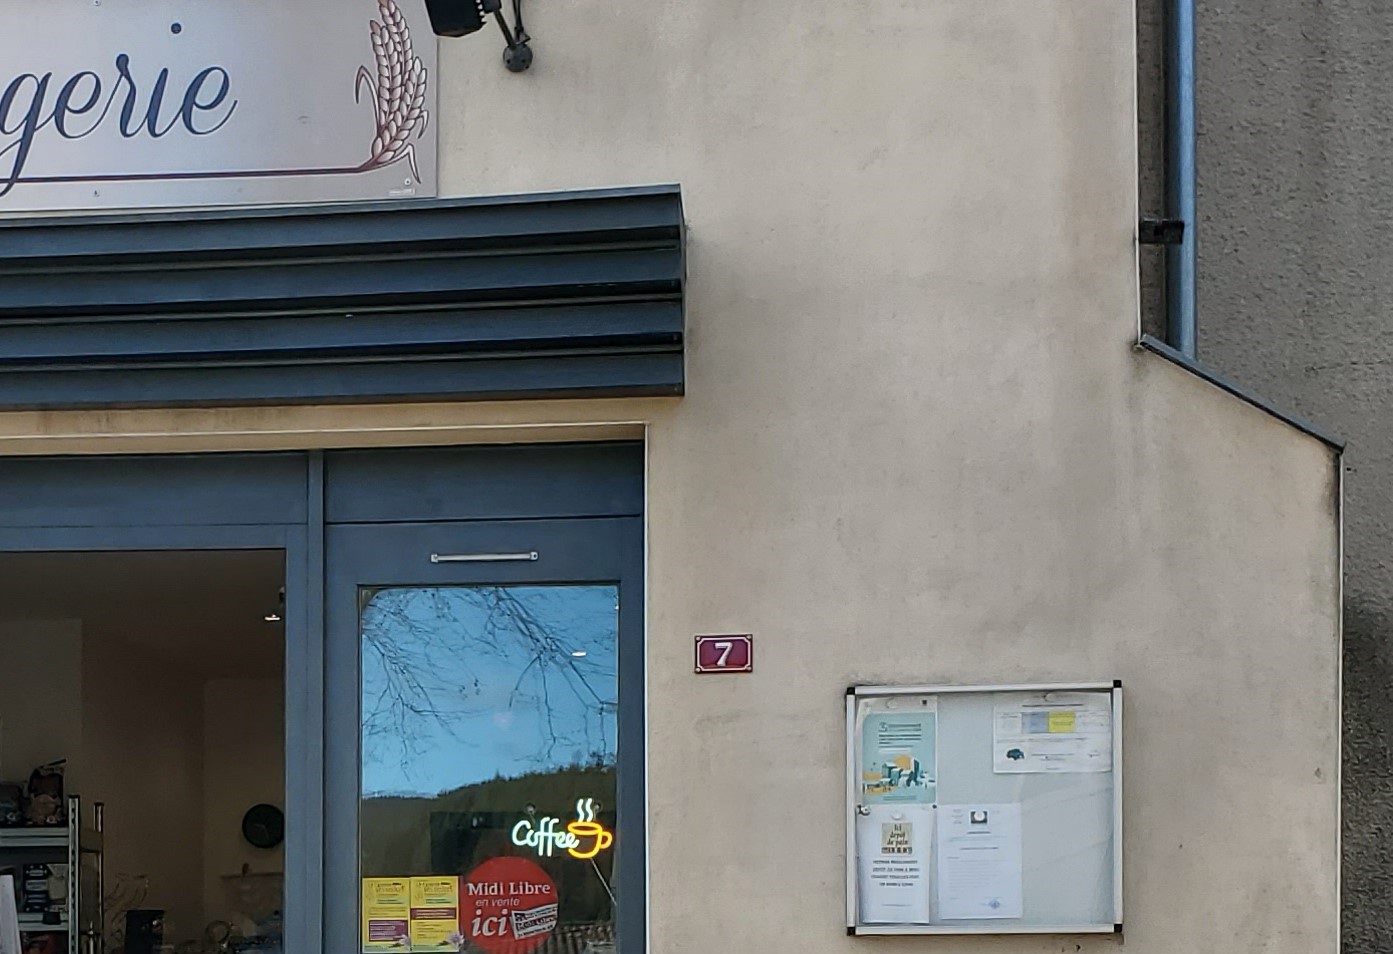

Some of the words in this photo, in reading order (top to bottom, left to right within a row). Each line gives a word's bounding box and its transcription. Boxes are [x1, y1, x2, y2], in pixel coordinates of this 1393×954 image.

[714, 642, 733, 667] 7
[512, 816, 580, 857] Coffee
[466, 881, 504, 896] Midi
[509, 881, 551, 896] Libre
[475, 899, 489, 908] en
[491, 897, 520, 907] vente
[471, 908, 509, 937] ici
